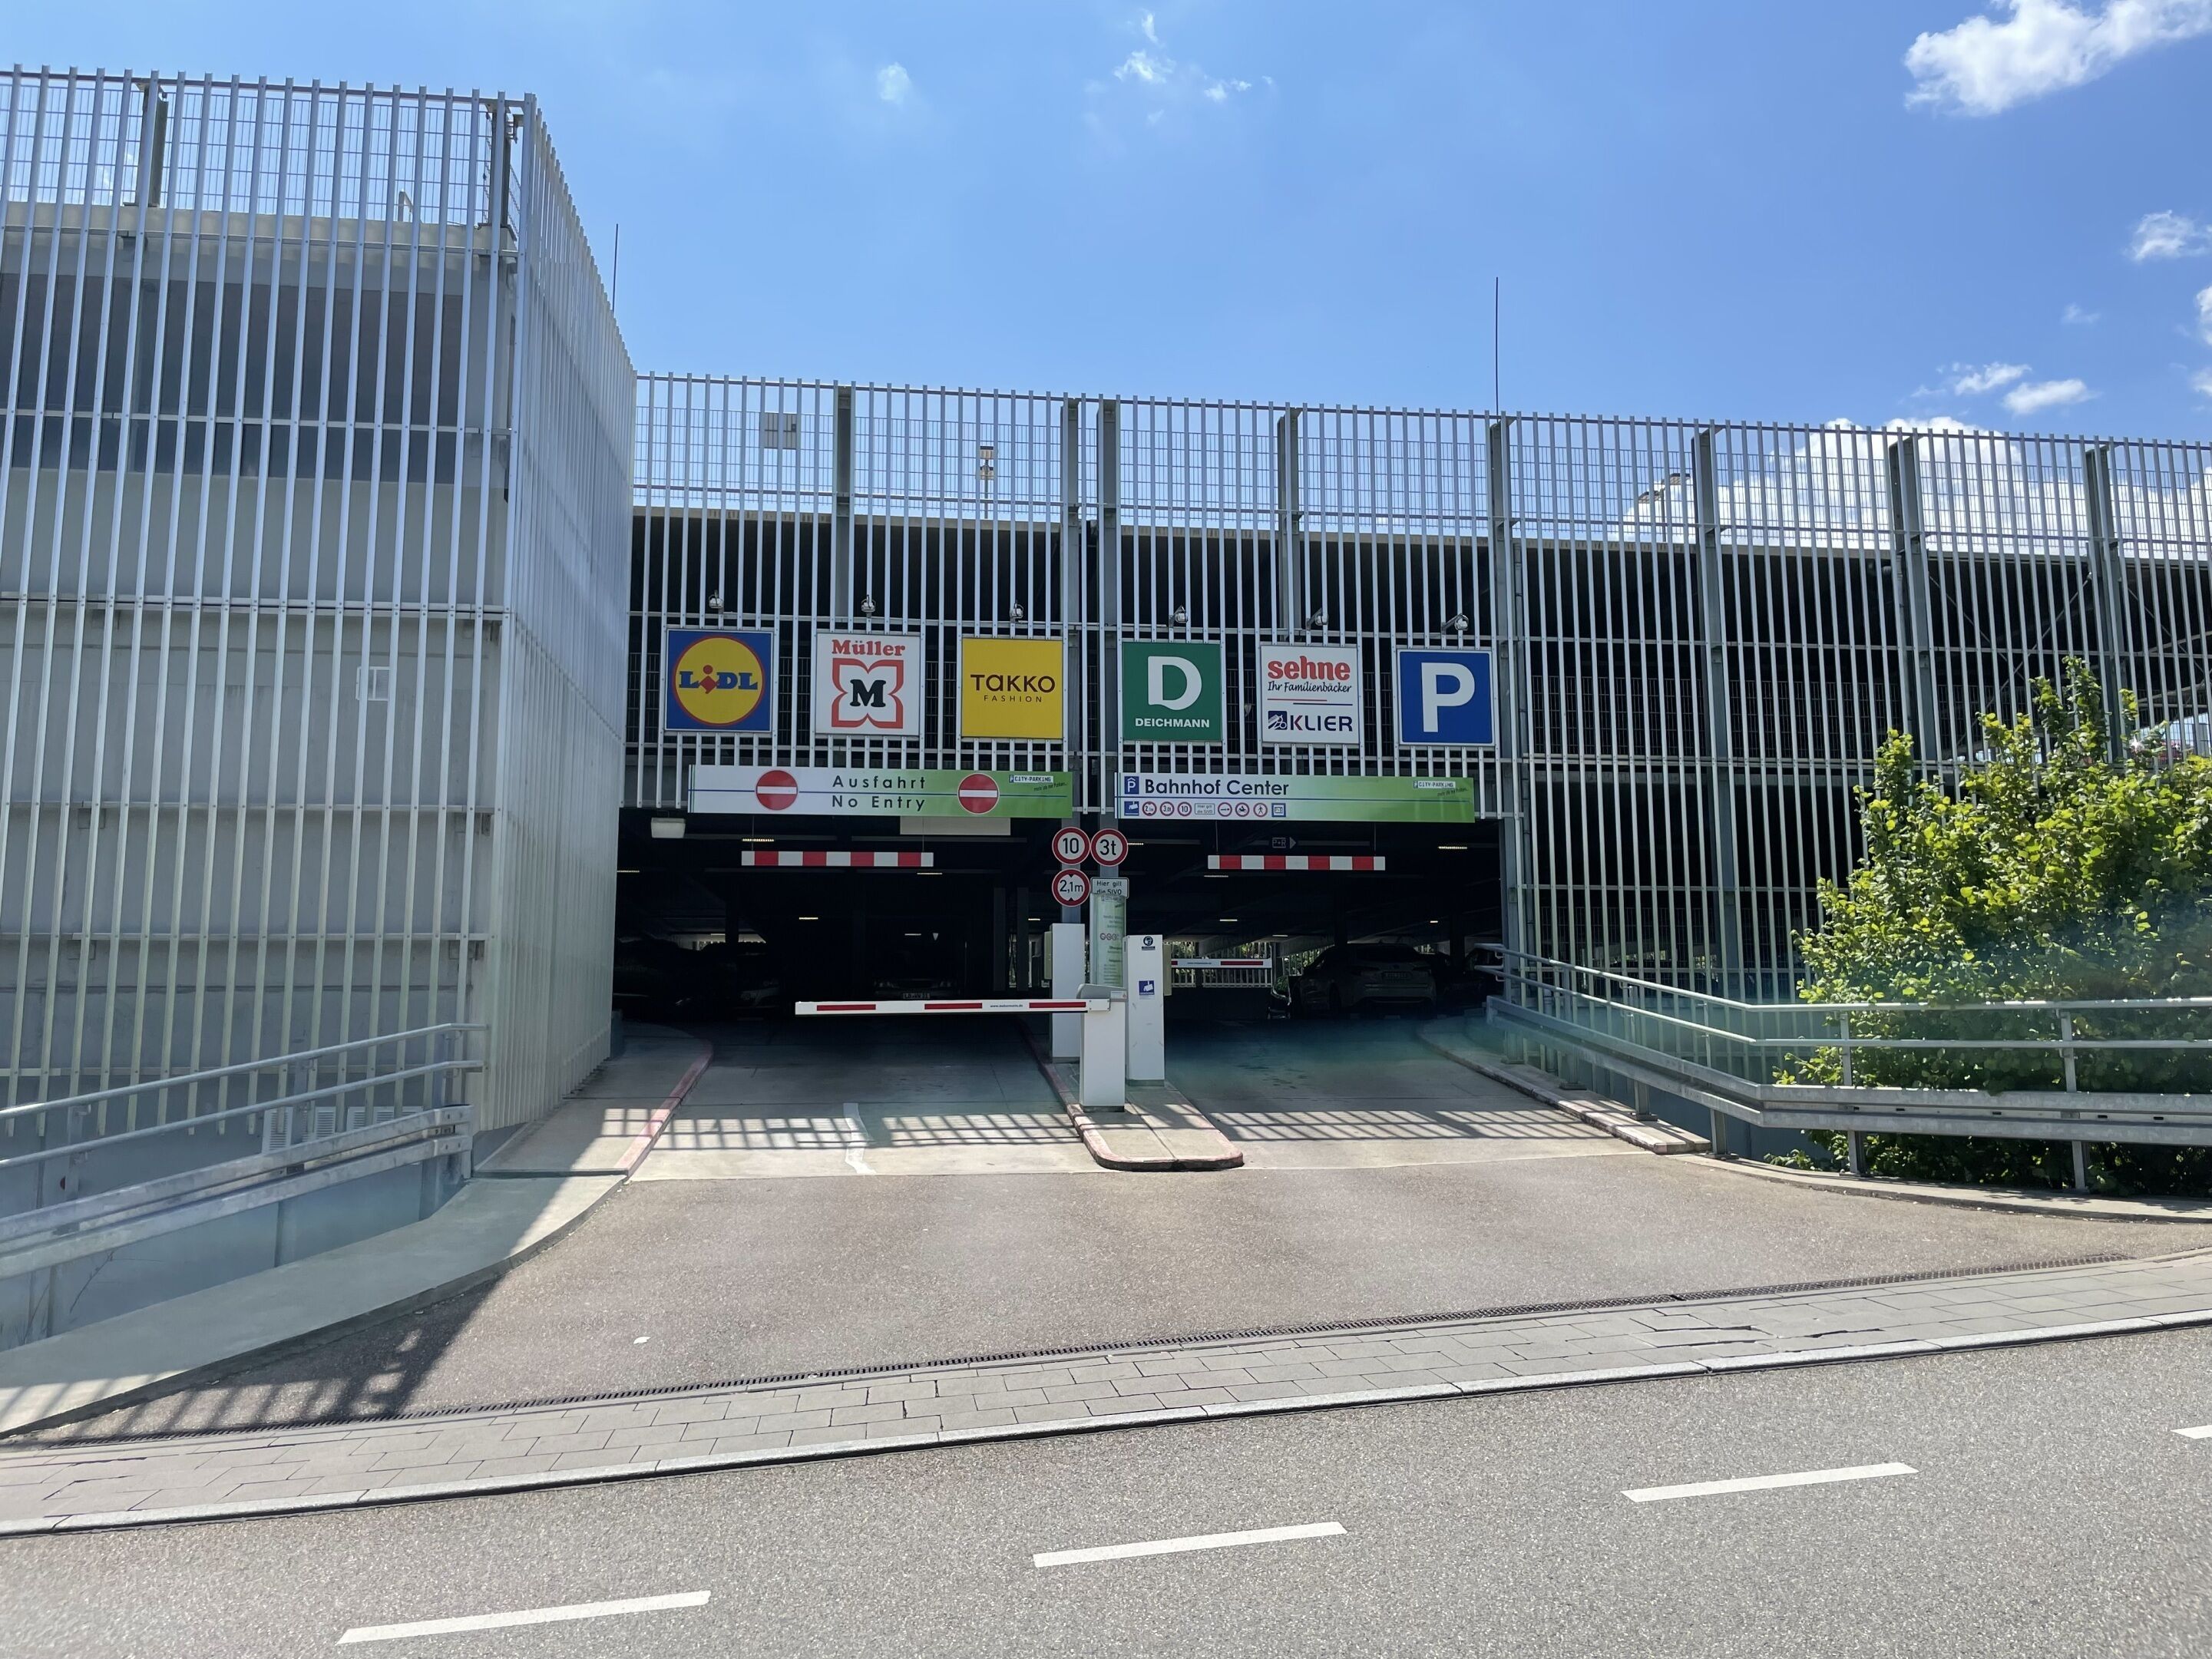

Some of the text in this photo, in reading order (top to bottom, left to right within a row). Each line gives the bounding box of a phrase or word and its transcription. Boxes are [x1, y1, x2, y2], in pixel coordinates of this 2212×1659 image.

[832, 639, 906, 657] Müller
[1268, 655, 1351, 681] sehne
[1147, 655, 1202, 711] D
[1268, 680, 1352, 693] Ihr Familienbäcker
[849, 678, 886, 708] M
[984, 695, 1043, 703] FASHION
[1420, 662, 1475, 733] P
[1135, 717, 1210, 729] DEICHMANN
[1290, 715, 1353, 732] KLIER
[832, 775, 926, 790] Ausfahrt
[1145, 778, 1221, 795] Bahnhof
[1226, 779, 1289, 795] Center
[832, 795, 926, 812] No Entry
[1062, 838, 1080, 854] 10
[1099, 839, 1117, 856] 3t
[1060, 879, 1083, 893] 2,1m
